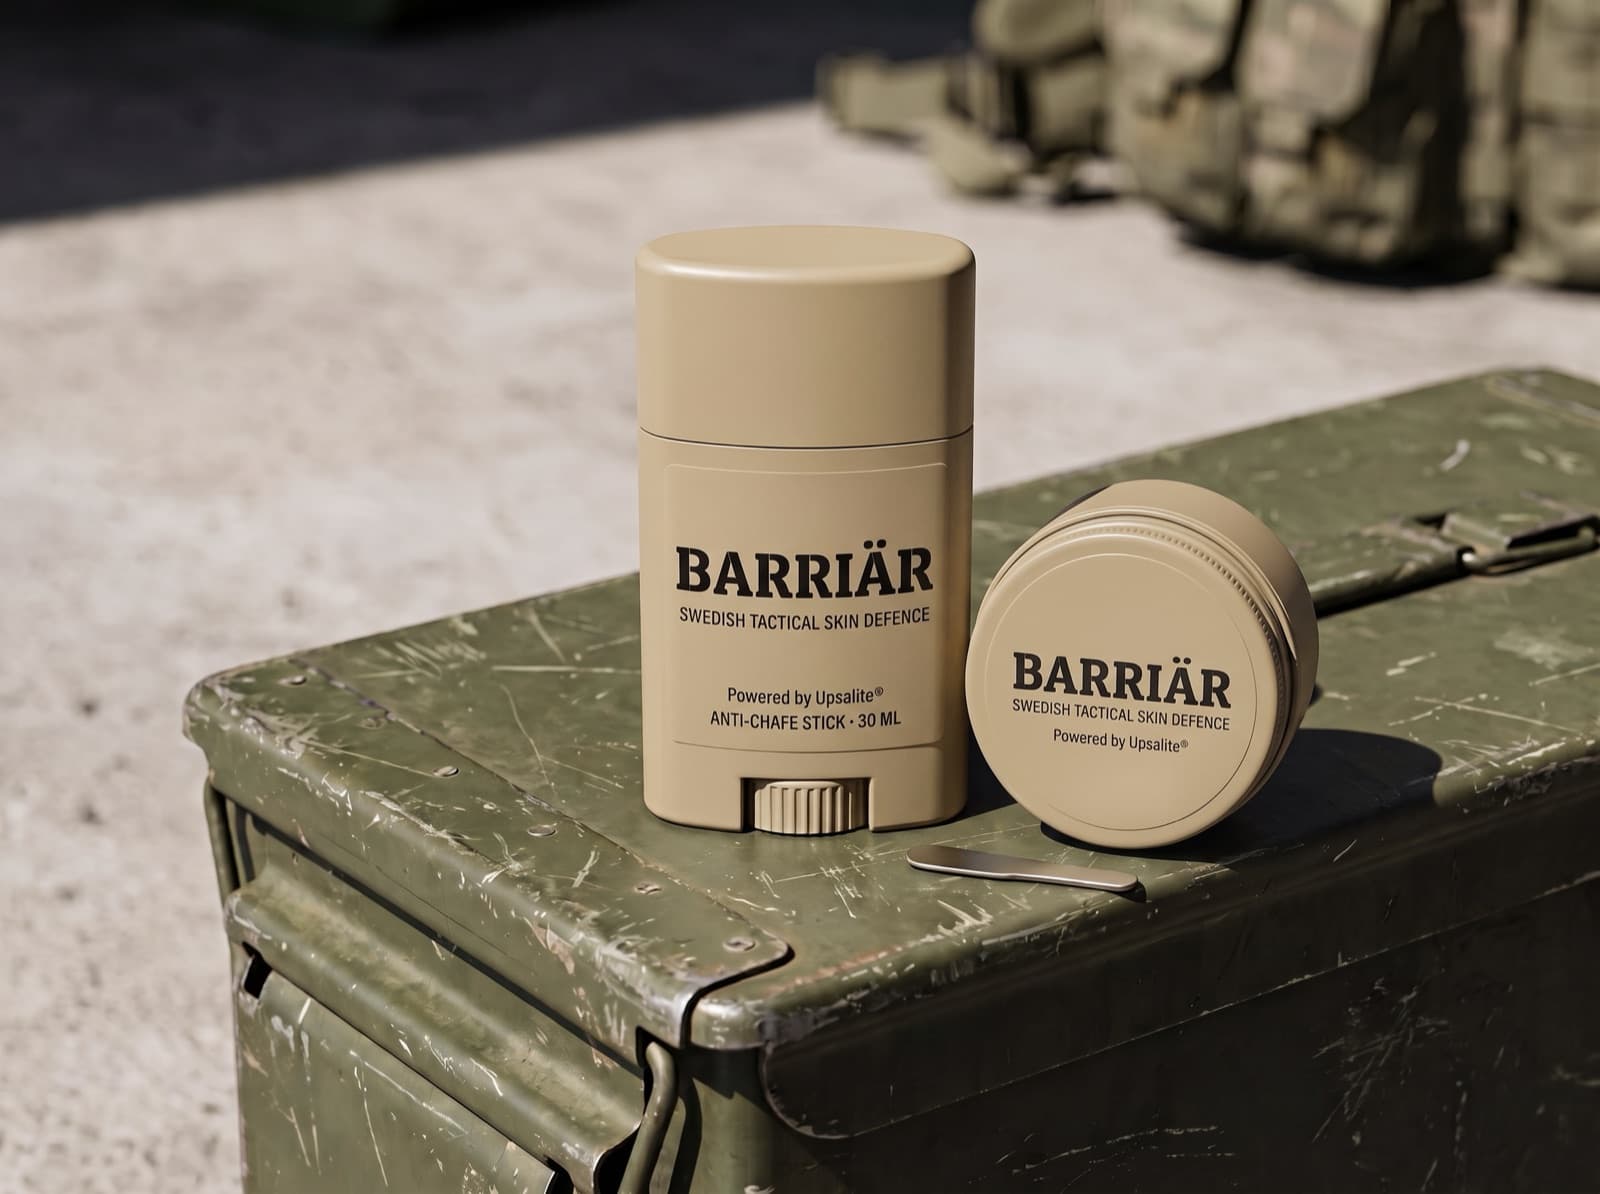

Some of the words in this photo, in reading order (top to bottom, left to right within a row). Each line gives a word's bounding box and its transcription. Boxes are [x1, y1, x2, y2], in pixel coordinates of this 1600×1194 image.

[676, 539, 933, 599] BARRIÄR
[679, 607, 745, 628] SWEDISH
[750, 614, 820, 630] TACTICAL
[824, 615, 859, 630] SKIN
[864, 606, 930, 628] DEFENCE
[1013, 651, 1231, 709] BARRIÄR
[728, 687, 790, 705] Powered
[795, 690, 811, 708] by
[710, 711, 798, 730] ANTI-CHAFE
[802, 715, 846, 730] STICK
[857, 713, 876, 728] 30
[881, 711, 902, 727] ML
[1012, 698, 1071, 716] SWEDISH
[1074, 703, 1134, 722] TACTICAL
[1137, 710, 1167, 725] SKIN
[1171, 713, 1230, 731] DEFENCE
[1053, 729, 1107, 746] Powered
[1111, 734, 1126, 750] by
